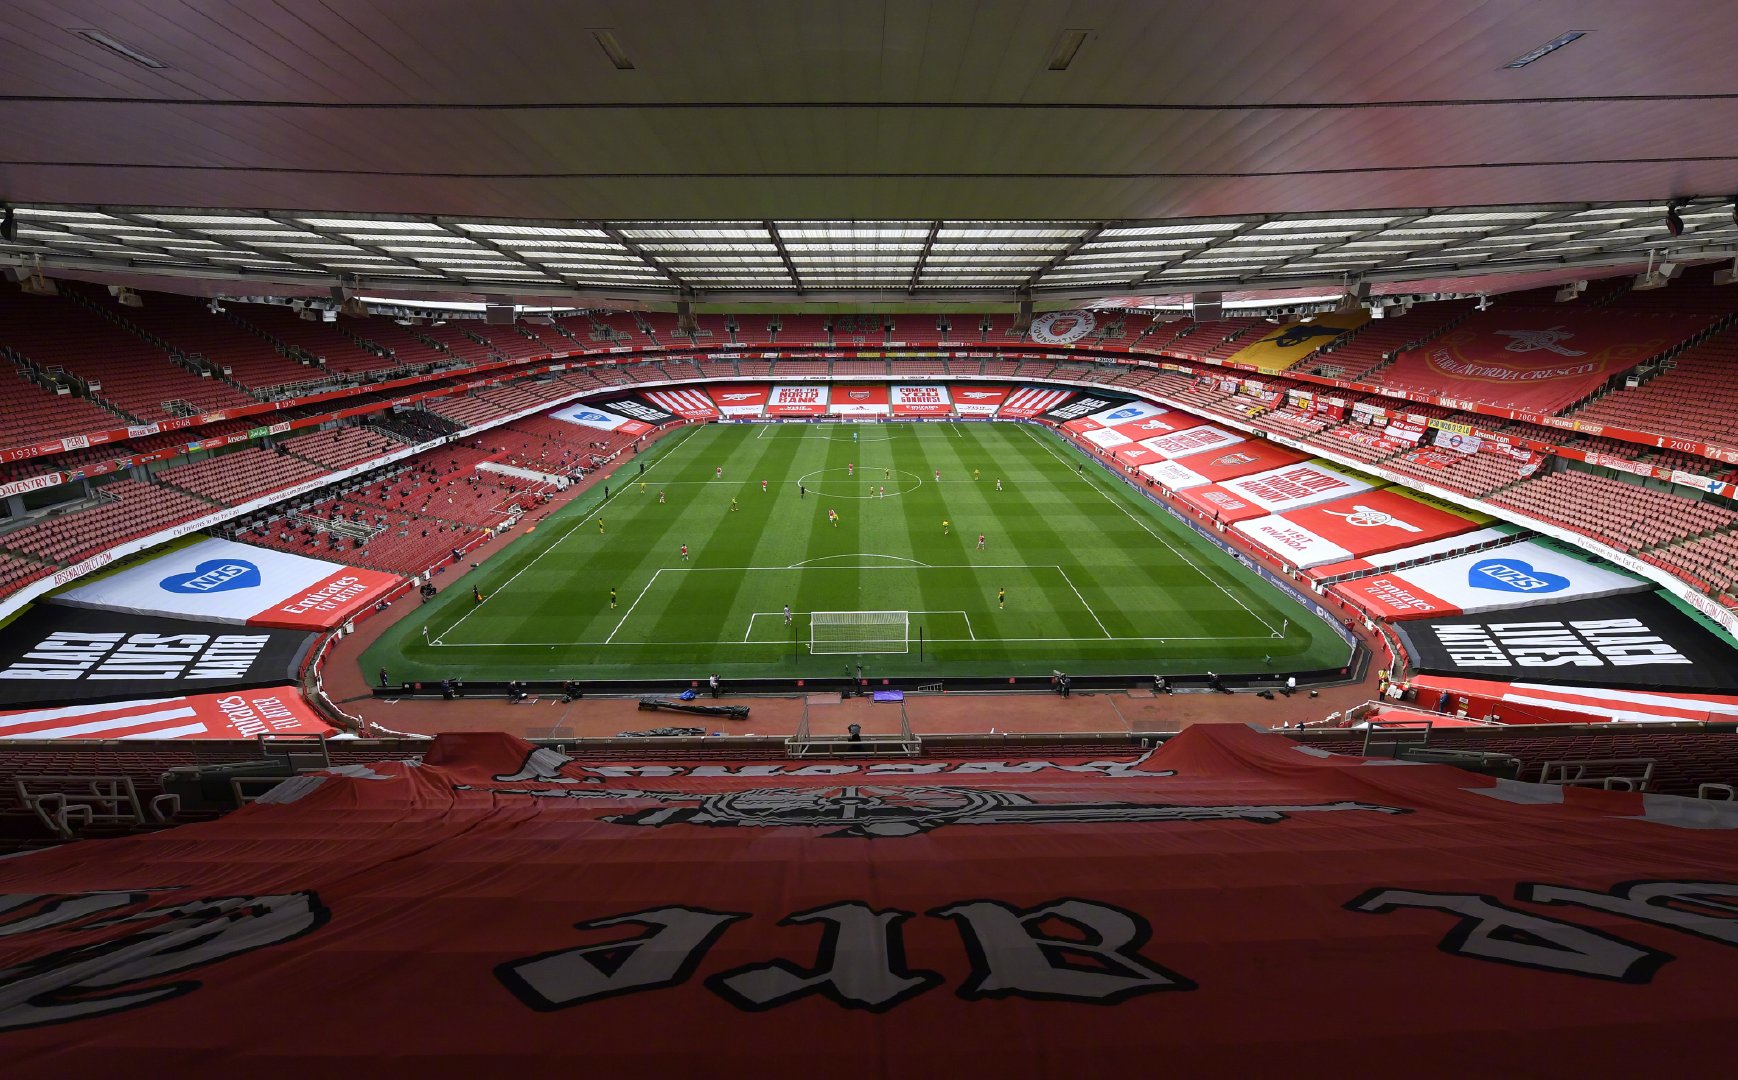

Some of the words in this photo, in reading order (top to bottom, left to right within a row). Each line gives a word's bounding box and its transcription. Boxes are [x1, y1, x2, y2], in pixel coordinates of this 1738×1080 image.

[1041, 313, 1056, 324] THE
[1439, 397, 1458, 408] WHL
[171, 419, 191, 429] 1948
[1518, 413, 1537, 422] 2004
[1552, 419, 1574, 428] YOURS
[66, 436, 85, 447] PERU
[227, 433, 248, 443] Arsenal
[1474, 430, 1510, 443] Arsenal.com
[1670, 440, 1697, 453] 2005
[10, 447, 38, 460] 1938
[1280, 467, 1351, 492] VICTORY
[1260, 527, 1308, 551] RWANDA
[1283, 528, 1314, 543] VISIT
[189, 565, 243, 590] NHS
[1488, 565, 1537, 590] NHS
[1632, 562, 1644, 572] East
[281, 575, 359, 614] Emirates
[315, 600, 337, 612] FLY
[337, 583, 369, 603] BETTER
[1372, 579, 1436, 611] Emirates
[1431, 624, 1513, 666] MATTER
[1486, 621, 1604, 666] LIVES
[1569, 618, 1693, 666] BLACK
[0, 631, 127, 680] BLACK
[86, 633, 211, 680] LIVES
[184, 634, 271, 680] MATTER
[217, 696, 276, 738] mirates
[252, 696, 292, 719] BETTER
[270, 717, 302, 730] FLY
